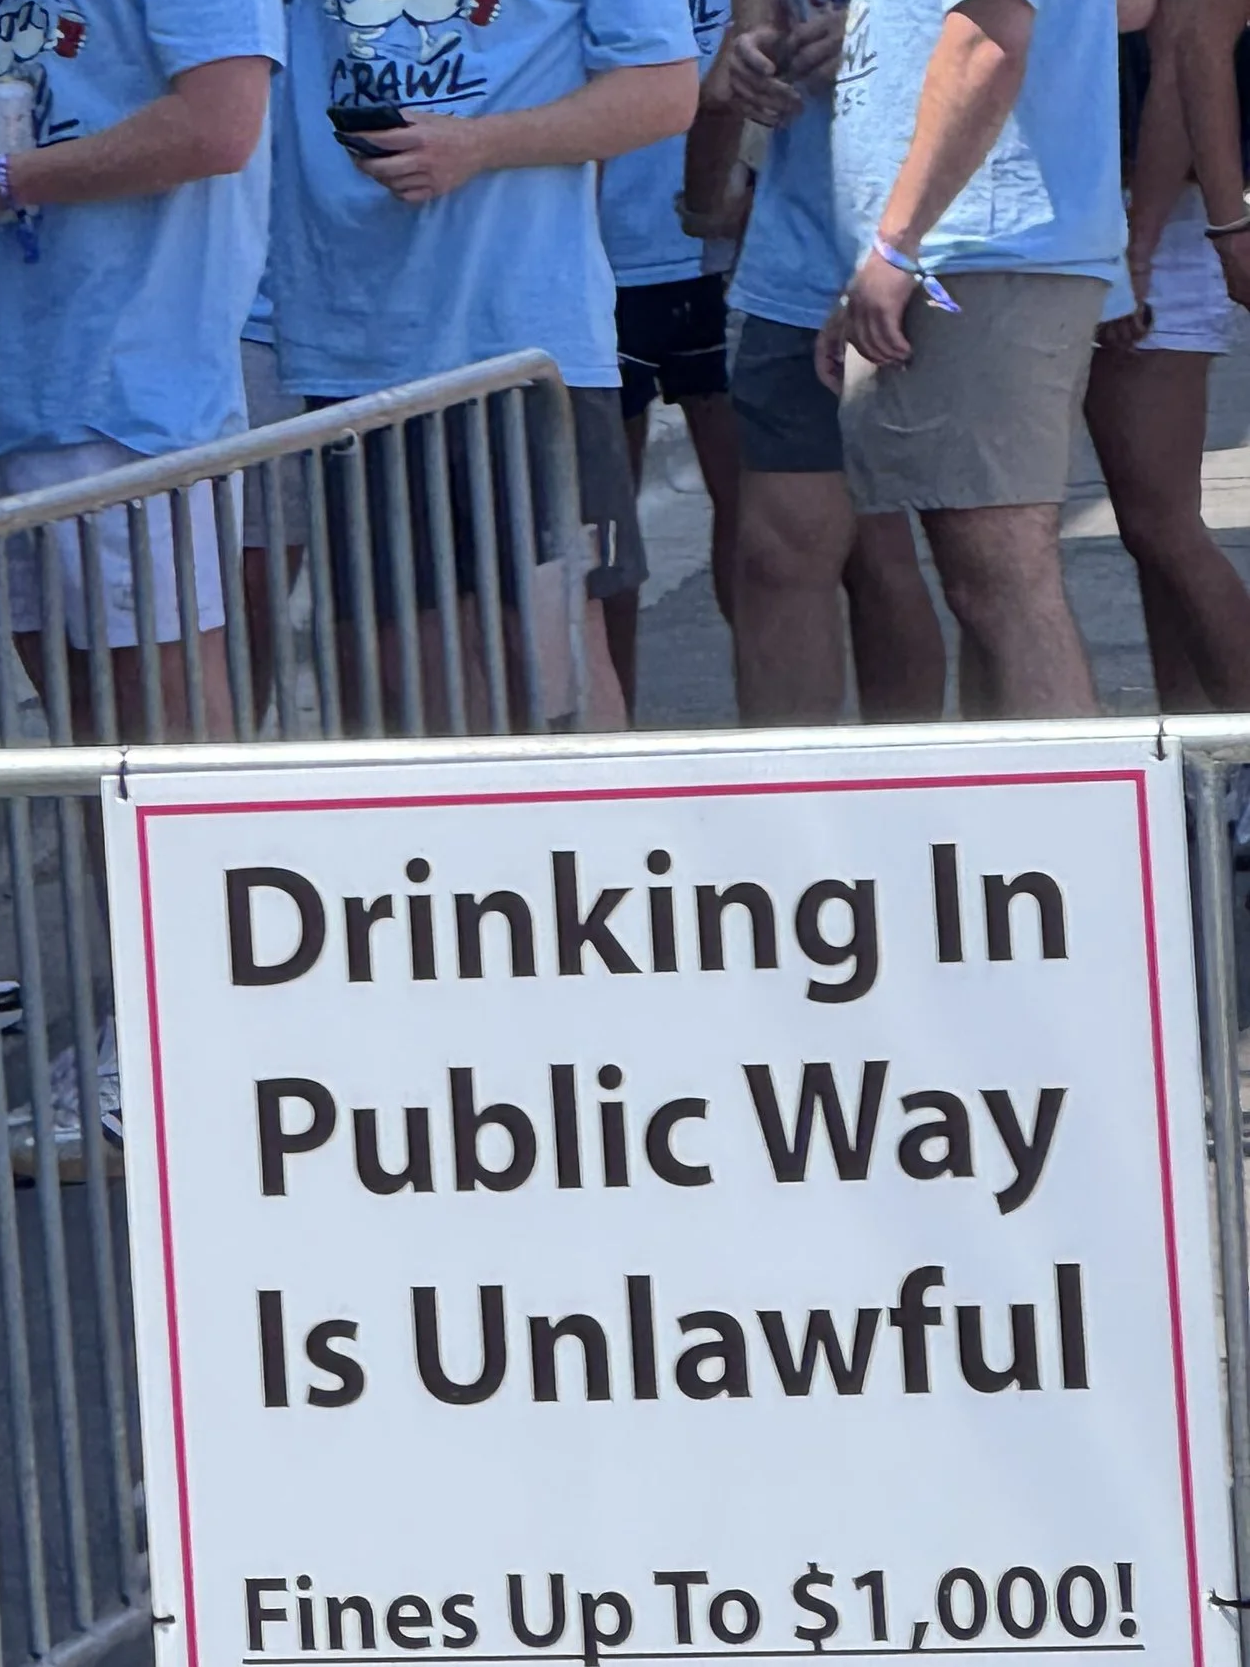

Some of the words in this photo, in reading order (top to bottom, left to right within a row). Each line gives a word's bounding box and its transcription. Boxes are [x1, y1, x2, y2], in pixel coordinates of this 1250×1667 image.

[330, 52, 488, 107] CRAWL
[223, 848, 880, 1004] Drinking
[930, 842, 1070, 964] In
[253, 1062, 715, 1198] Public
[740, 1059, 1069, 1216] Way
[257, 1288, 366, 1409] Is
[409, 1262, 1091, 1406] Unlawful
[244, 1573, 479, 1653] Fines
[506, 1572, 634, 1667] Up
[652, 1569, 761, 1646] To
[791, 1561, 1140, 1654] $1,000!
